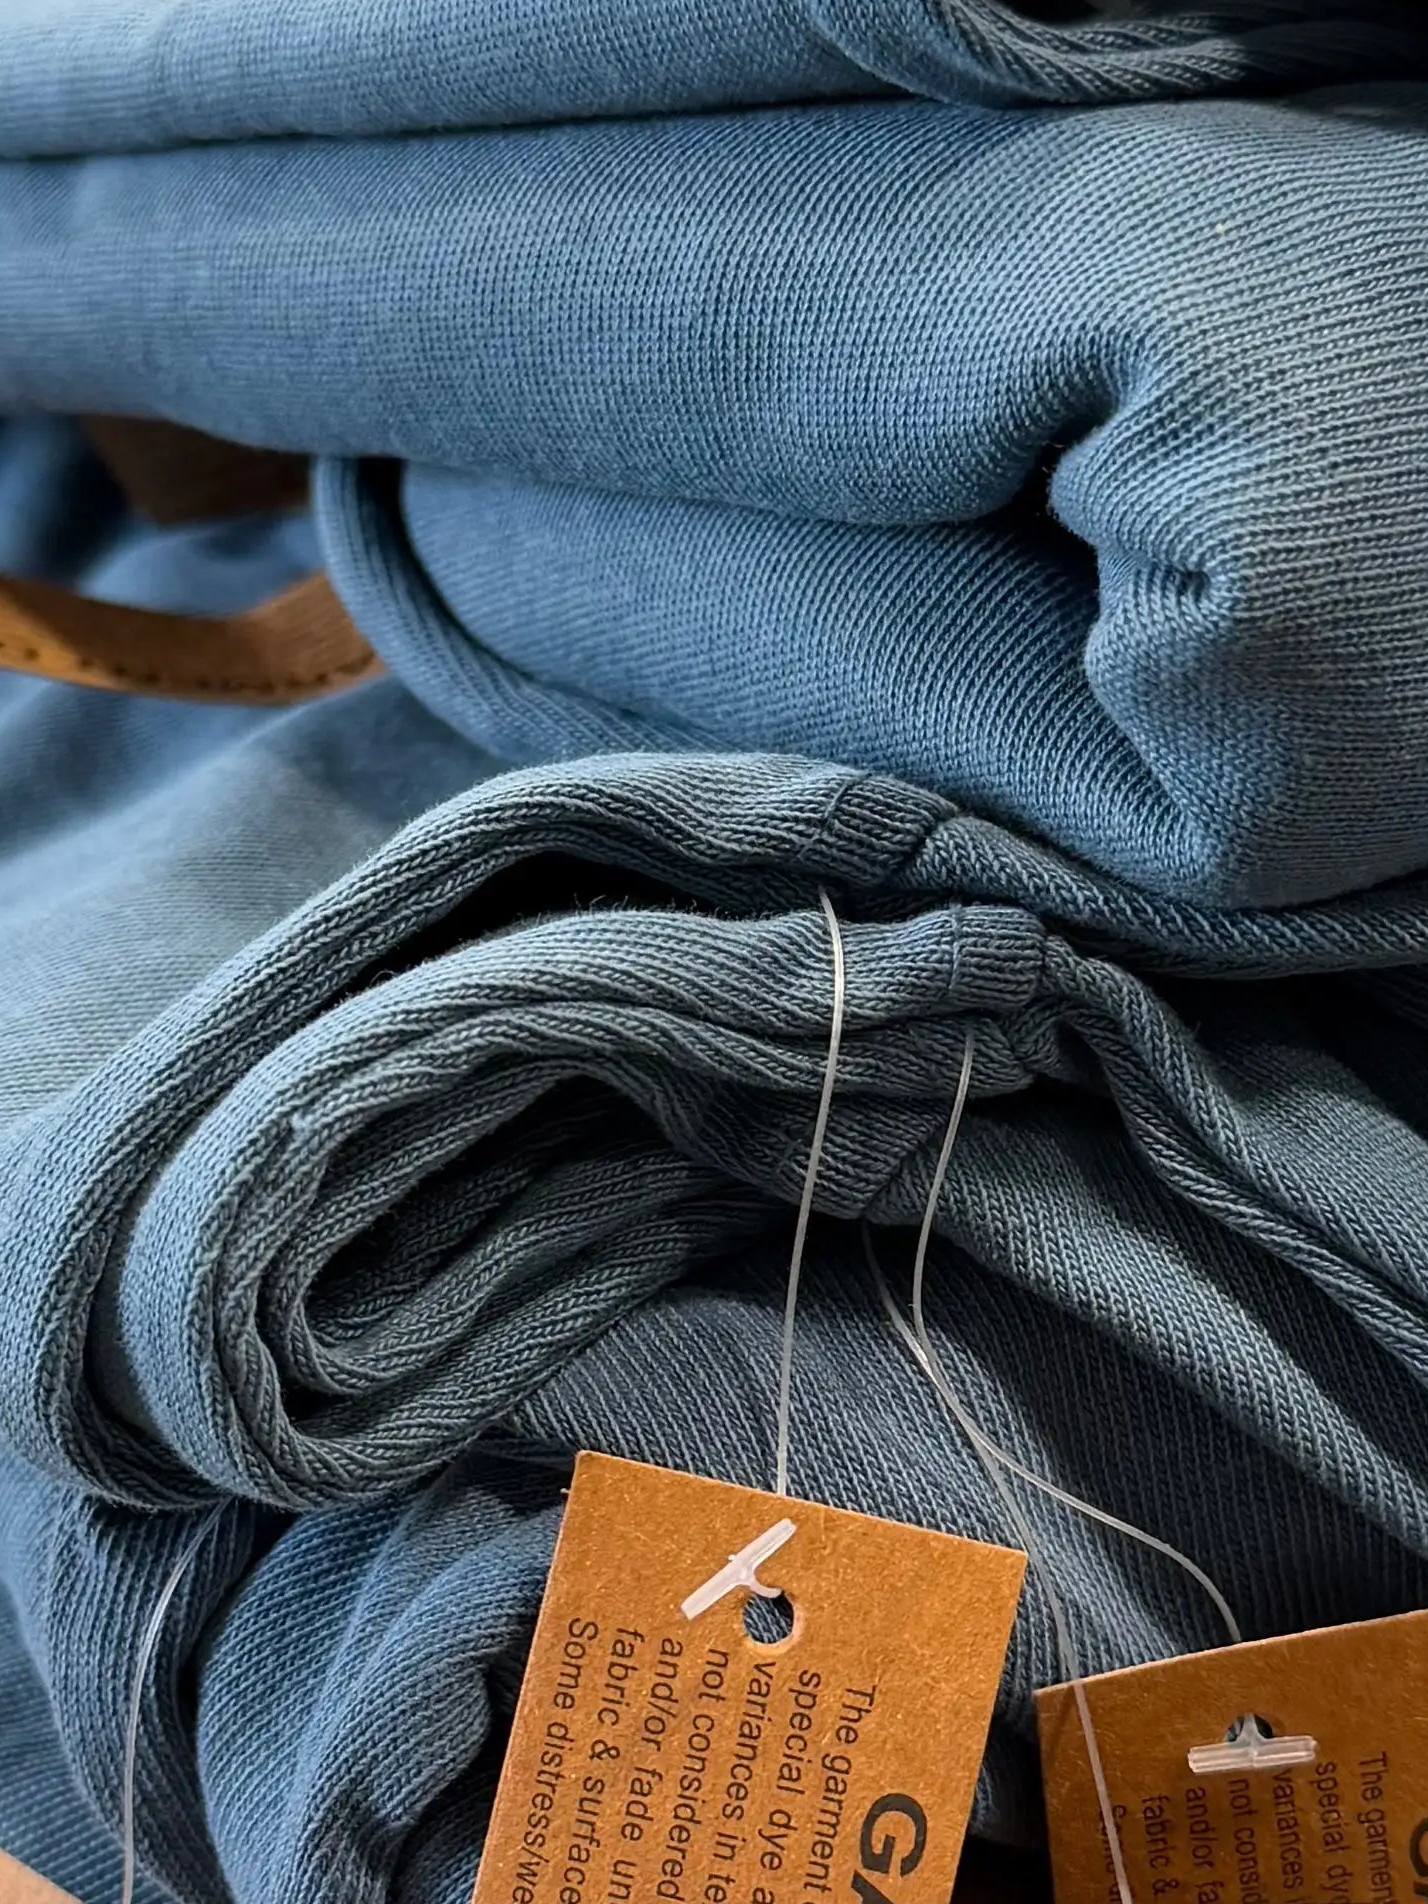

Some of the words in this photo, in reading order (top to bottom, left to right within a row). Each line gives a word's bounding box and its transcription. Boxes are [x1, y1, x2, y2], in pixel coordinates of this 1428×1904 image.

[550, 1616, 600, 1710] Some
[595, 1626, 646, 1727] fabric
[639, 1636, 684, 1753] and/or
[695, 1647, 731, 1703] not
[586, 1737, 621, 1762] &
[720, 1660, 777, 1822] variances
[774, 1668, 822, 1796] special
[833, 1683, 878, 1746] The
[618, 1765, 664, 1842] fade
[654, 1712, 716, 1903] considered
[1226, 1776, 1260, 1819] not
[1306, 1759, 1353, 1854] special
[1356, 1749, 1390, 1803] The
[710, 1830, 748, 1862] in
[756, 1807, 799, 1872] dye
[801, 1751, 853, 1894] garment
[1139, 1793, 1177, 1871] fabric
[1183, 1784, 1220, 1869] and/or
[1269, 1766, 1305, 1891] variances
[1149, 1876, 1183, 1898] &
